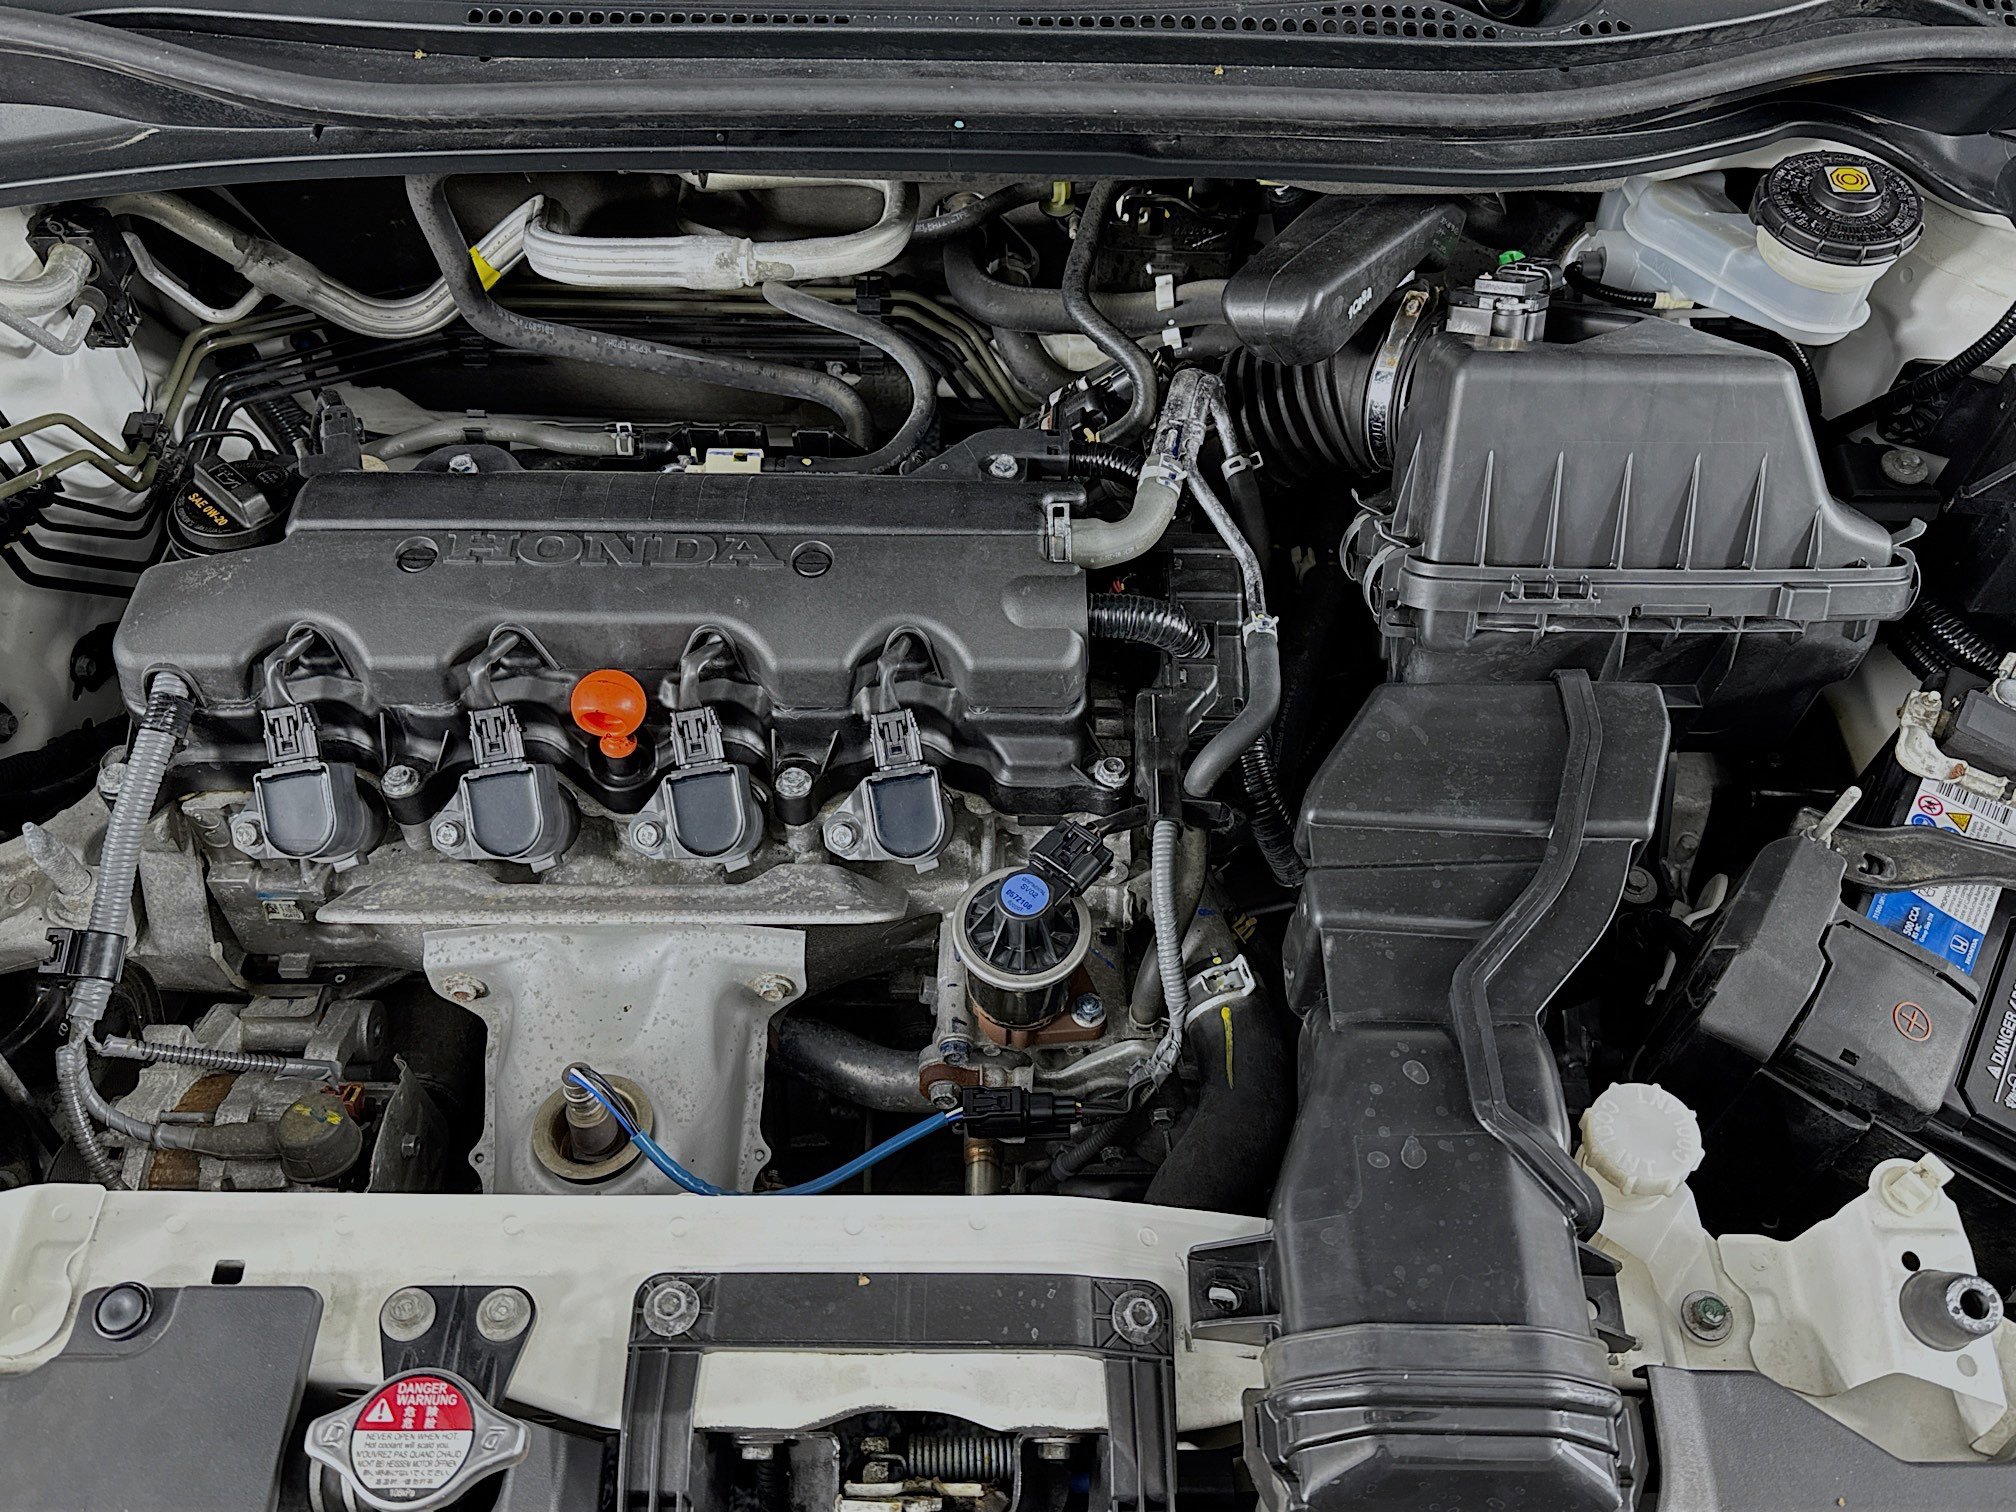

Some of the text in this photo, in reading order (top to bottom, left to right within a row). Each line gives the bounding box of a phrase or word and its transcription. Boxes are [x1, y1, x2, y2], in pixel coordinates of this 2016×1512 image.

[187, 492, 209, 509] SAE
[202, 505, 228, 526] 0W-20
[443, 532, 787, 567] HONDA
[1903, 906, 1921, 937] 500 CCA
[1919, 930, 1927, 943] Group
[1964, 938, 1980, 966] HONDA
[1990, 1010, 2016, 1066] DANGER
[396, 1382, 449, 1395] DANGER
[396, 1394, 458, 1406] WARNUNG
[366, 1433, 392, 1441] NEVER
[394, 1433, 416, 1441] OPEN
[417, 1432, 440, 1441] WHEN
[377, 1441, 404, 1449] coolant
[393, 1450, 408, 1459] PAS
[409, 1450, 435, 1459] QUAND
[412, 1460, 434, 1468] MOTOR
